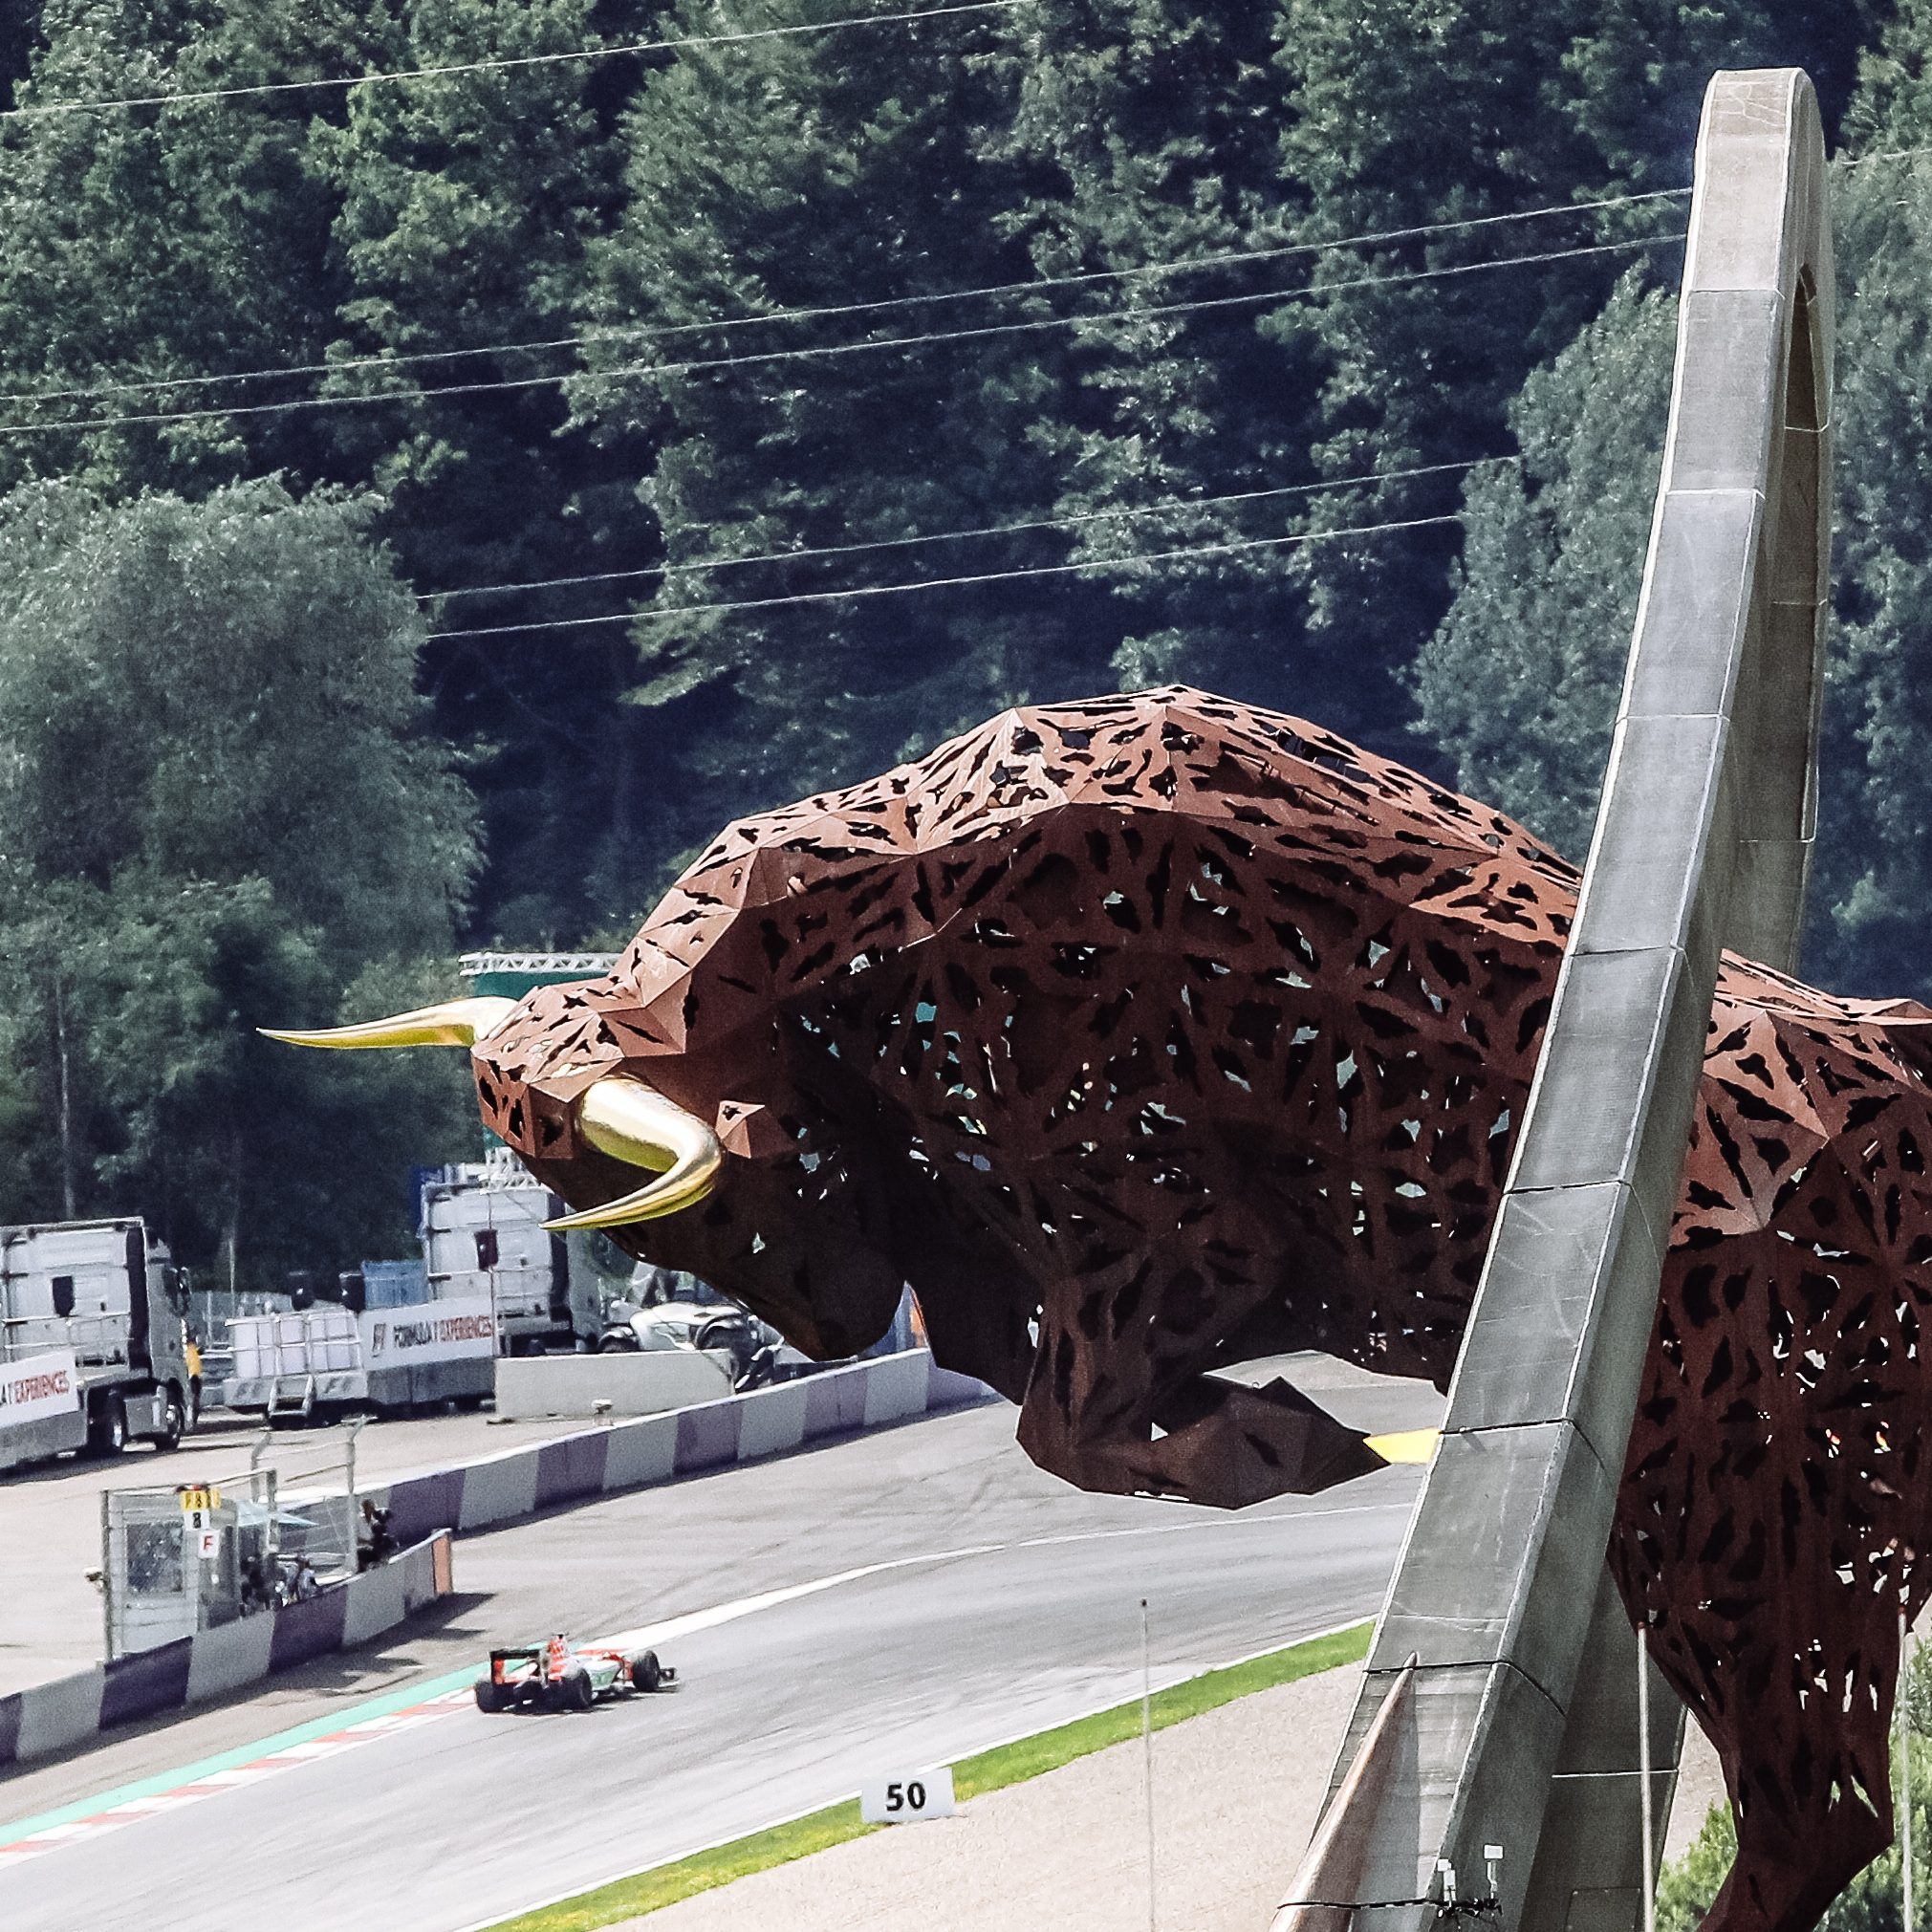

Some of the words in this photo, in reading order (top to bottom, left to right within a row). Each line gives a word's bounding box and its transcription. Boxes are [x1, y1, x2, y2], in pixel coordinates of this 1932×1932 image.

[14, 1370, 70, 1404] EXPERIENCES
[193, 1512, 202, 1529] 8
[204, 1535, 213, 1551] F
[886, 1782, 926, 1812] 50
